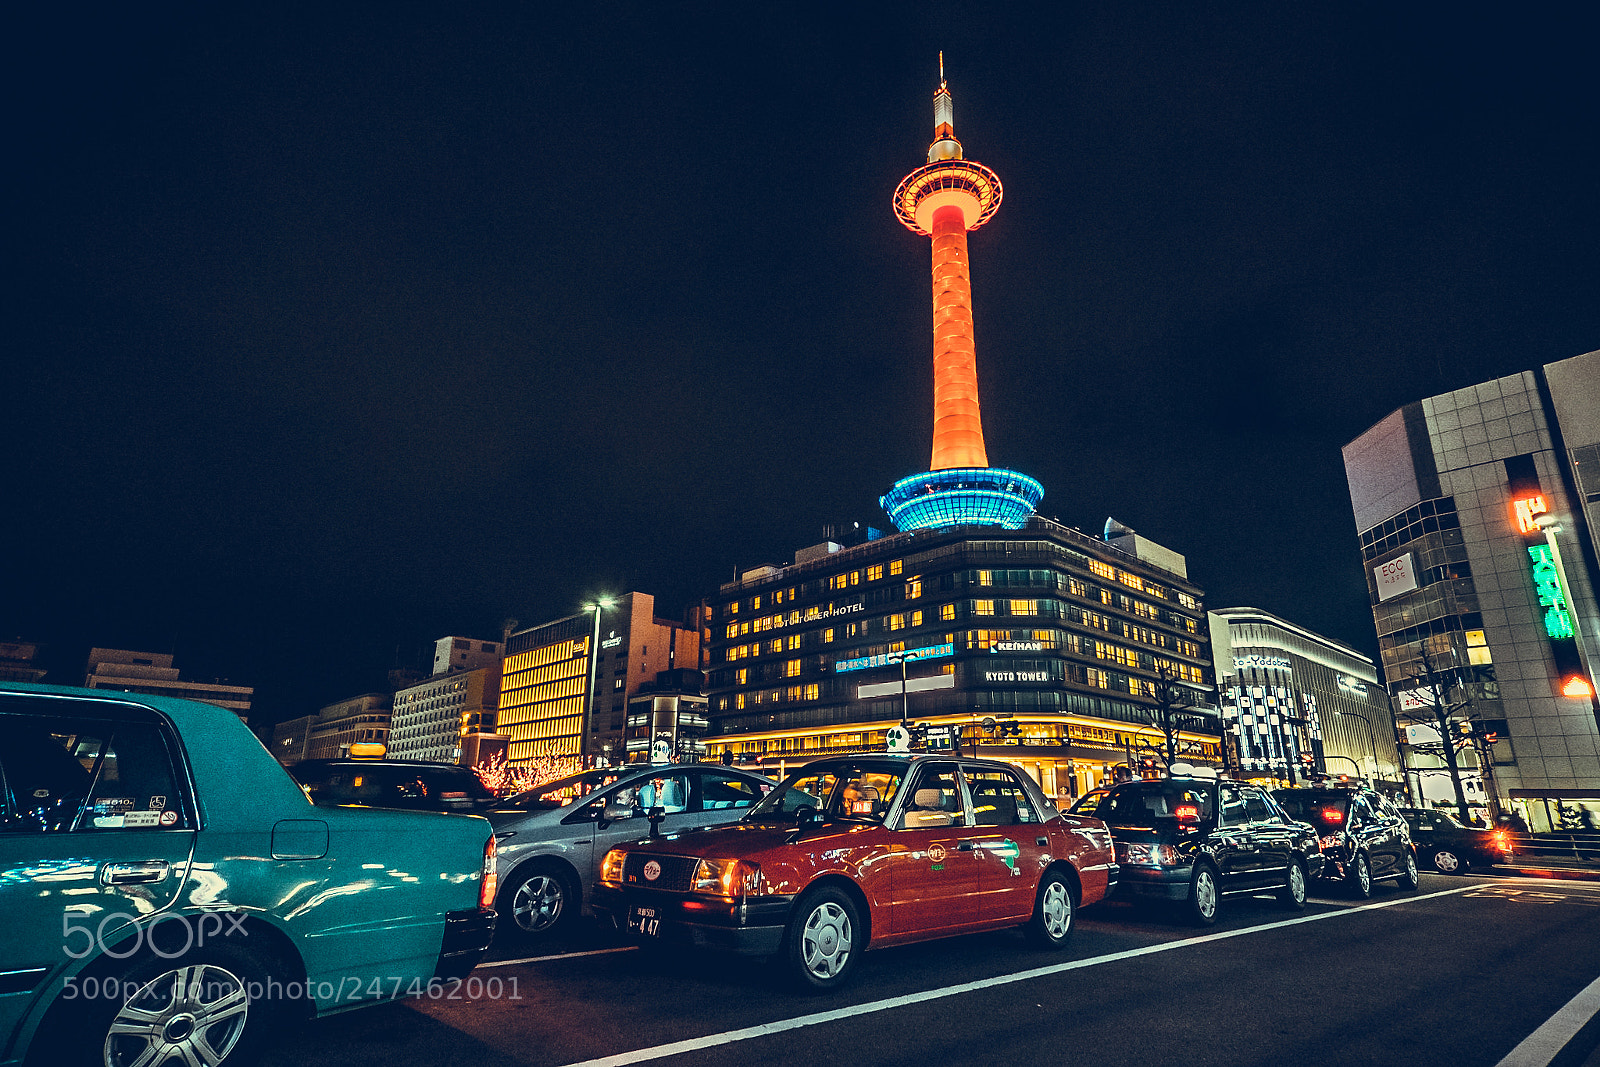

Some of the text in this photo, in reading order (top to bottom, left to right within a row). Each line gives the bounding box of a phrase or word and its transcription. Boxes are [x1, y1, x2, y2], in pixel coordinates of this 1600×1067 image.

[1382, 559, 1403, 576] ECC
[798, 610, 829, 624] TOWER
[833, 602, 865, 616] HOTEL
[997, 641, 1042, 651] KEIHAN
[985, 671, 1048, 681] KYOTO TOWER
